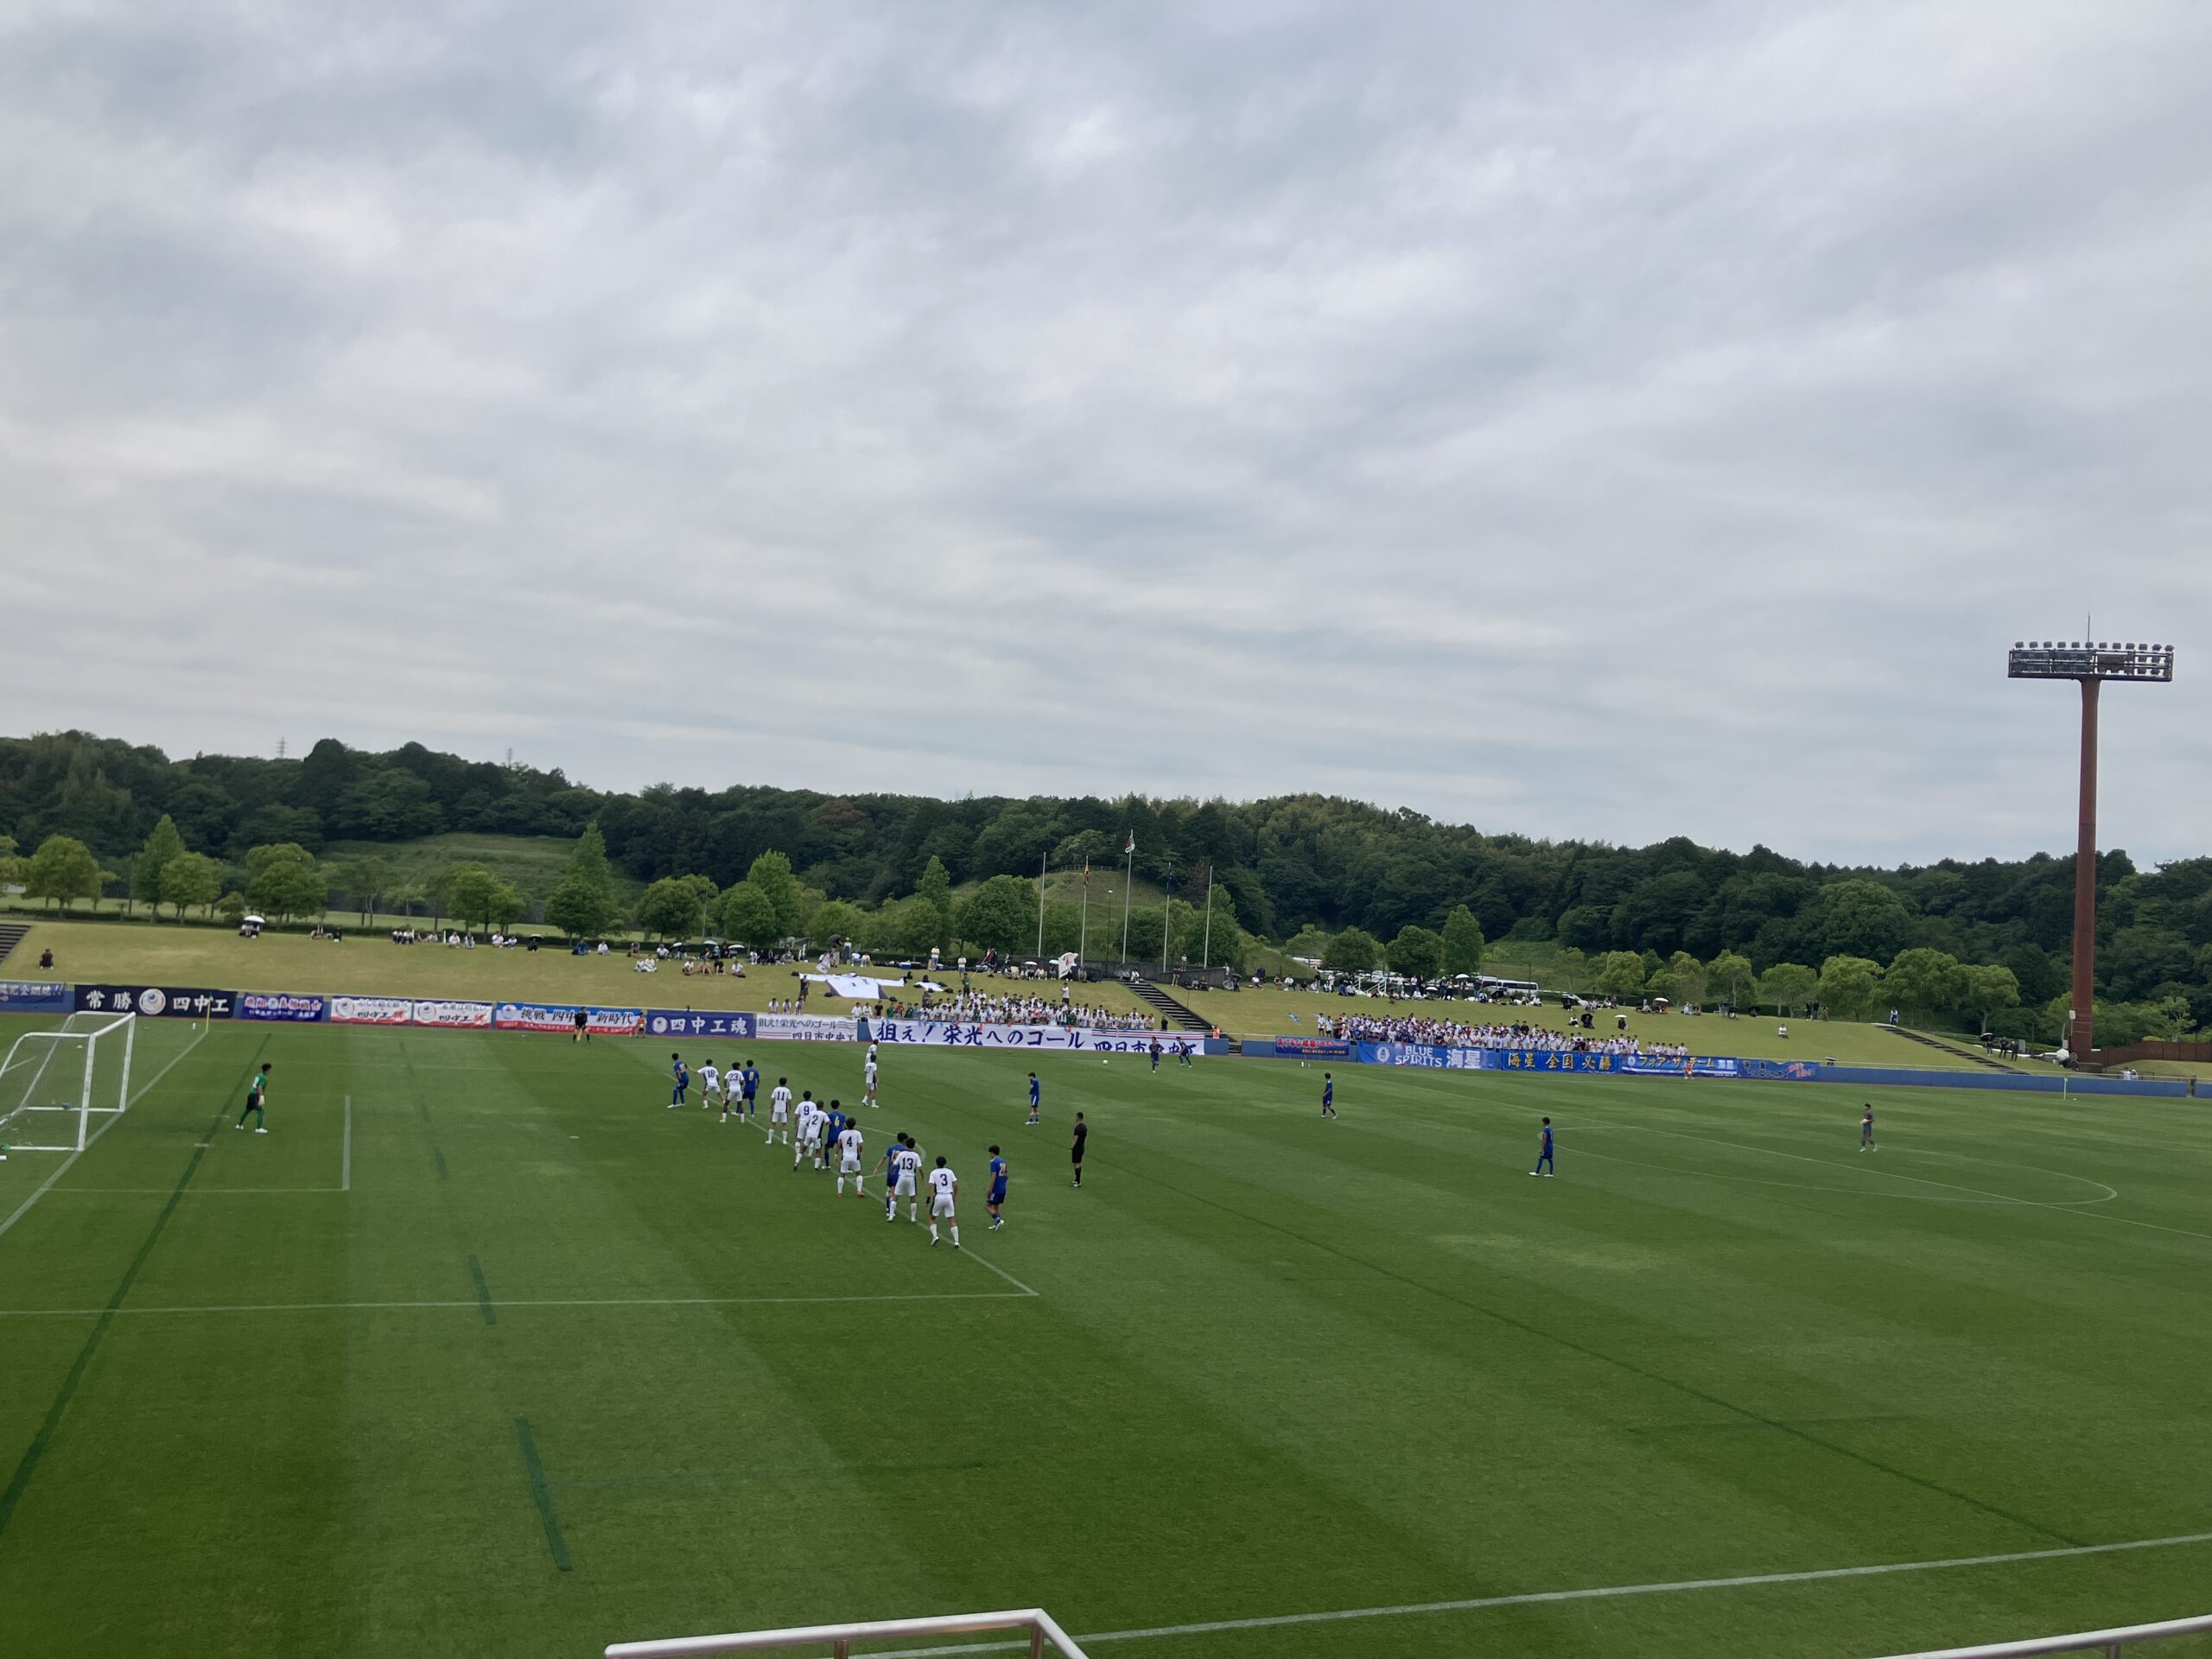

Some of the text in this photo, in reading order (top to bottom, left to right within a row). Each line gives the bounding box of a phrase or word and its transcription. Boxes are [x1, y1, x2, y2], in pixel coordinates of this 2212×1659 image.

[86, 990, 132, 1010] 常勝
[173, 995, 229, 1013] 四中工
[596, 1011, 634, 1025] 新時代
[671, 1016, 747, 1035] 四中工魂
[877, 1022, 1084, 1049] 狙え!栄光へのゴール
[1405, 1045, 1433, 1057] BLUE
[1395, 1054, 1442, 1067] SPIRITS
[1446, 1048, 1480, 1069] 海星
[1508, 1052, 1611, 1071] 海星 全国 必勝
[708, 1070, 715, 1078] 18
[728, 1073, 738, 1082] 23
[777, 1090, 785, 1100] 11
[804, 1105, 810, 1116] 9
[811, 1115, 818, 1125] 2
[847, 1135, 853, 1147] 4
[902, 1158, 913, 1170] 13
[940, 1173, 948, 1186] 3
